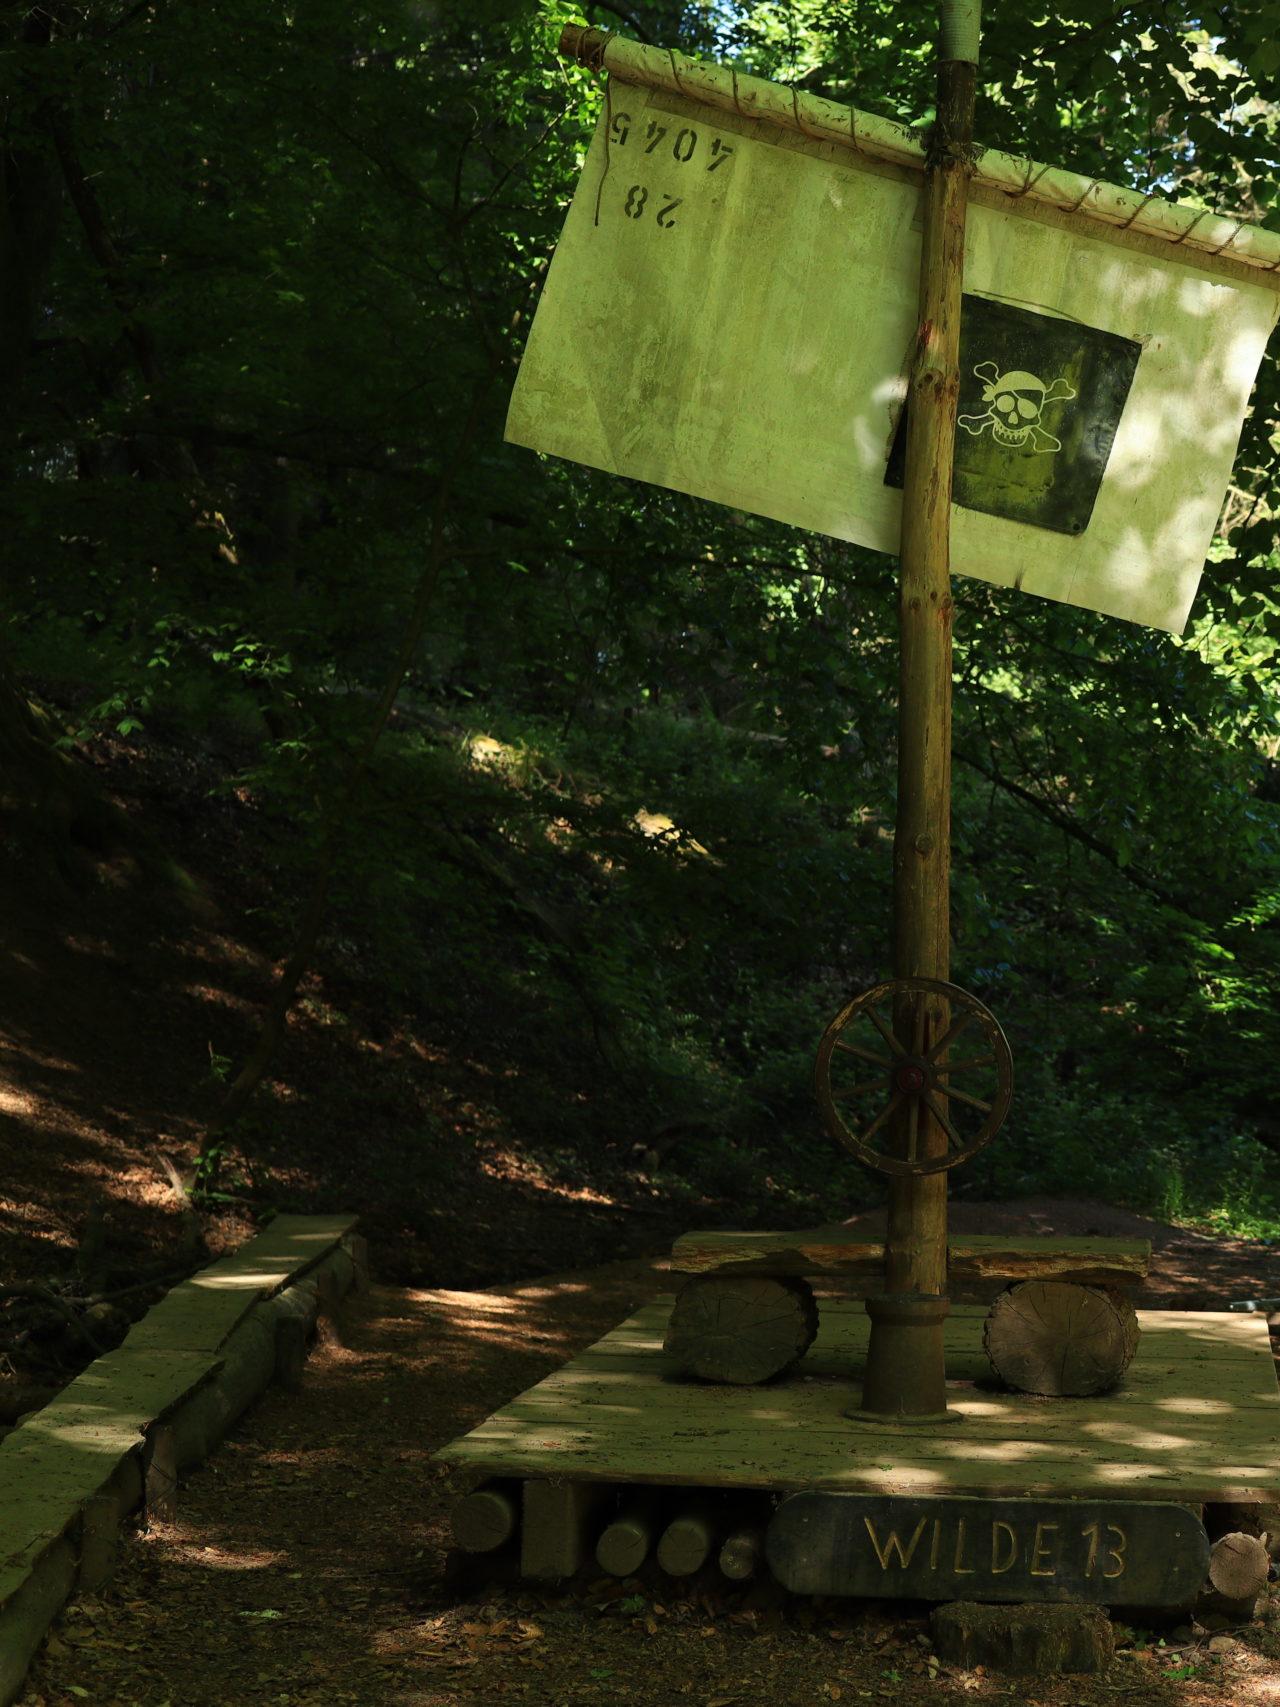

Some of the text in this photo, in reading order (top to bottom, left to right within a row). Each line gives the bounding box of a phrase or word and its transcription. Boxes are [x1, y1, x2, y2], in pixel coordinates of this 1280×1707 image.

[609, 111, 734, 172] 4045
[624, 184, 684, 229] 28
[863, 1515, 1128, 1578] WILDE 13
